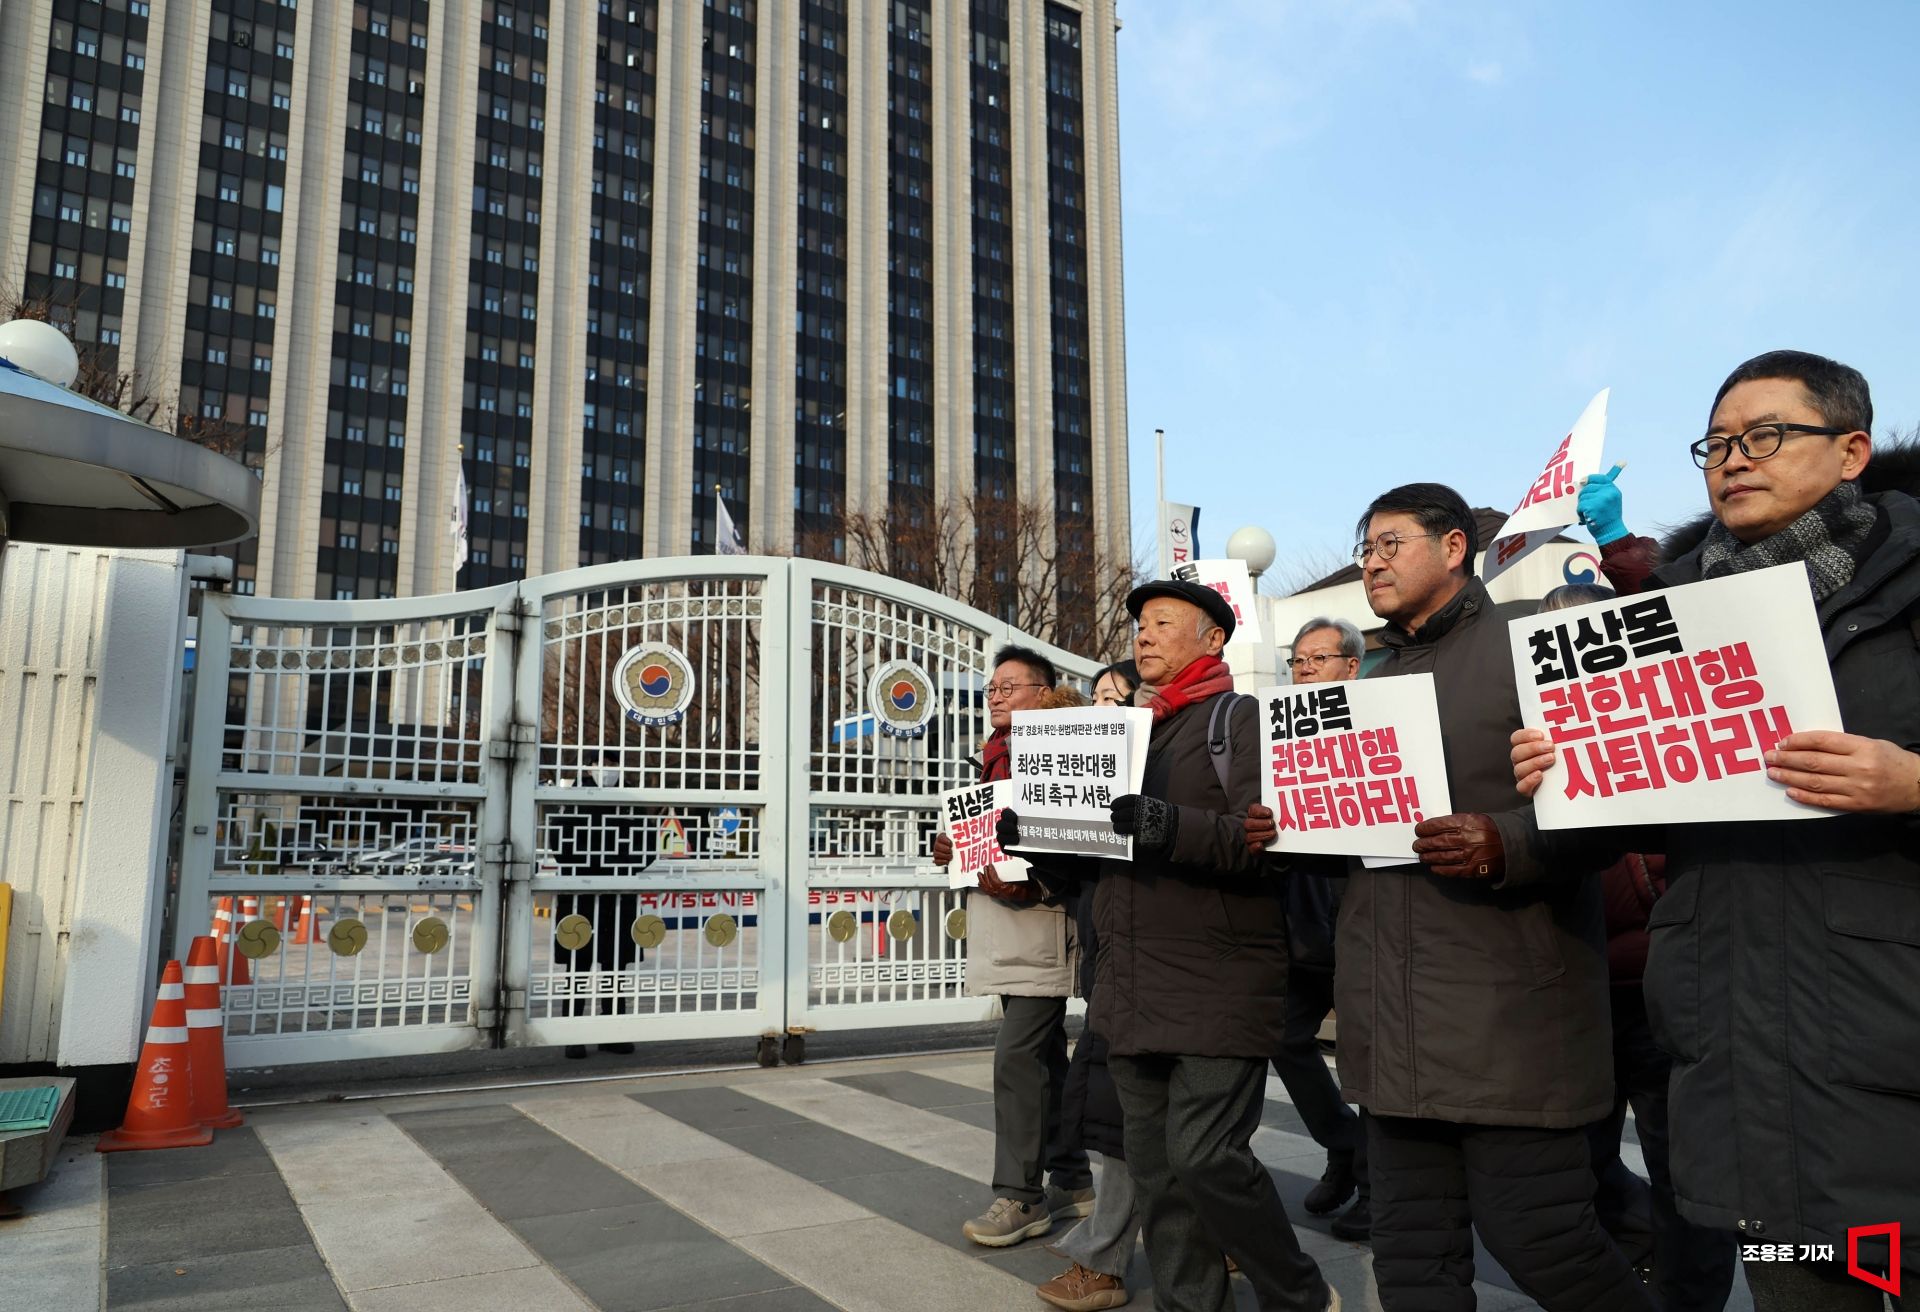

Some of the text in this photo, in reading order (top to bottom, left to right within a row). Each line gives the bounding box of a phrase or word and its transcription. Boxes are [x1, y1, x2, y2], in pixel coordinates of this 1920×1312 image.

[1528, 595, 1683, 686] 최상목
[1540, 641, 1764, 744] 권한대행
[633, 713, 677, 725] 대한민국
[1269, 685, 1353, 741] 최상목
[886, 726, 921, 736] 대한민국
[1026, 725, 1043, 736] 경호처
[1094, 723, 1109, 735] 선별
[1110, 723, 1125, 735] 임명
[1018, 753, 1116, 778] 최상목 권한대행
[1272, 727, 1402, 787] 권한대행
[948, 785, 993, 822] 최상목
[1021, 783, 1111, 808] 사퇴 촉구 서한
[1278, 777, 1424, 832] 사퇴하라!
[1029, 825, 1042, 837] 즉각
[1044, 827, 1058, 839] 퇴진
[1059, 828, 1098, 842] 사회대개혁
